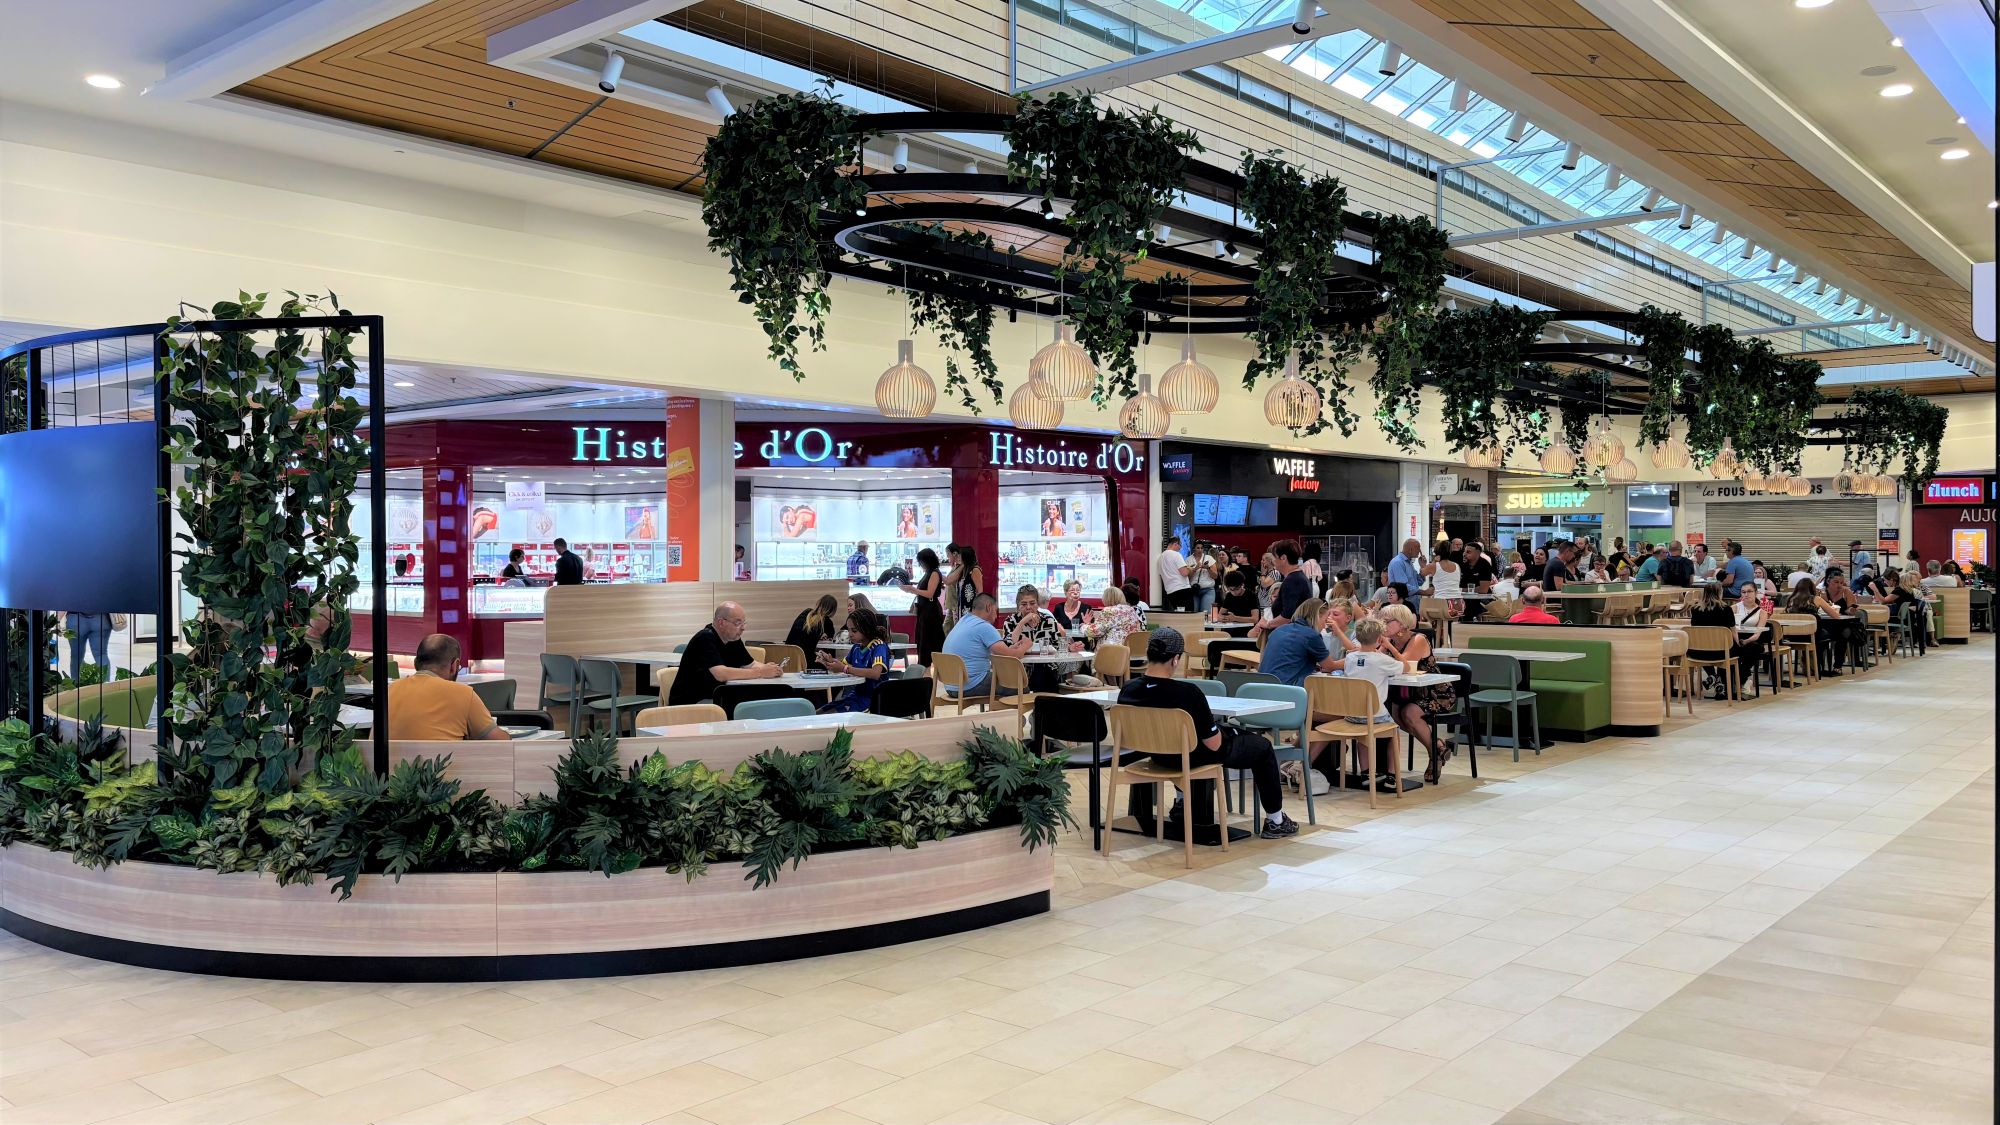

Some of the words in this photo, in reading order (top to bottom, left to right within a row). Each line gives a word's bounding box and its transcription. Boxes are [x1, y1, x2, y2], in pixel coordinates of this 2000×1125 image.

[989, 432, 1088, 468] Histoire
[1096, 443, 1144, 473] d'Or
[1163, 461, 1186, 469] WAFFLE
[1273, 457, 1315, 477] WAFFLE
[1290, 475, 1320, 493] factory
[1717, 486, 1745, 496] FOUS
[1928, 483, 1980, 497] flunch
[1505, 490, 1591, 509] SUBWAY
